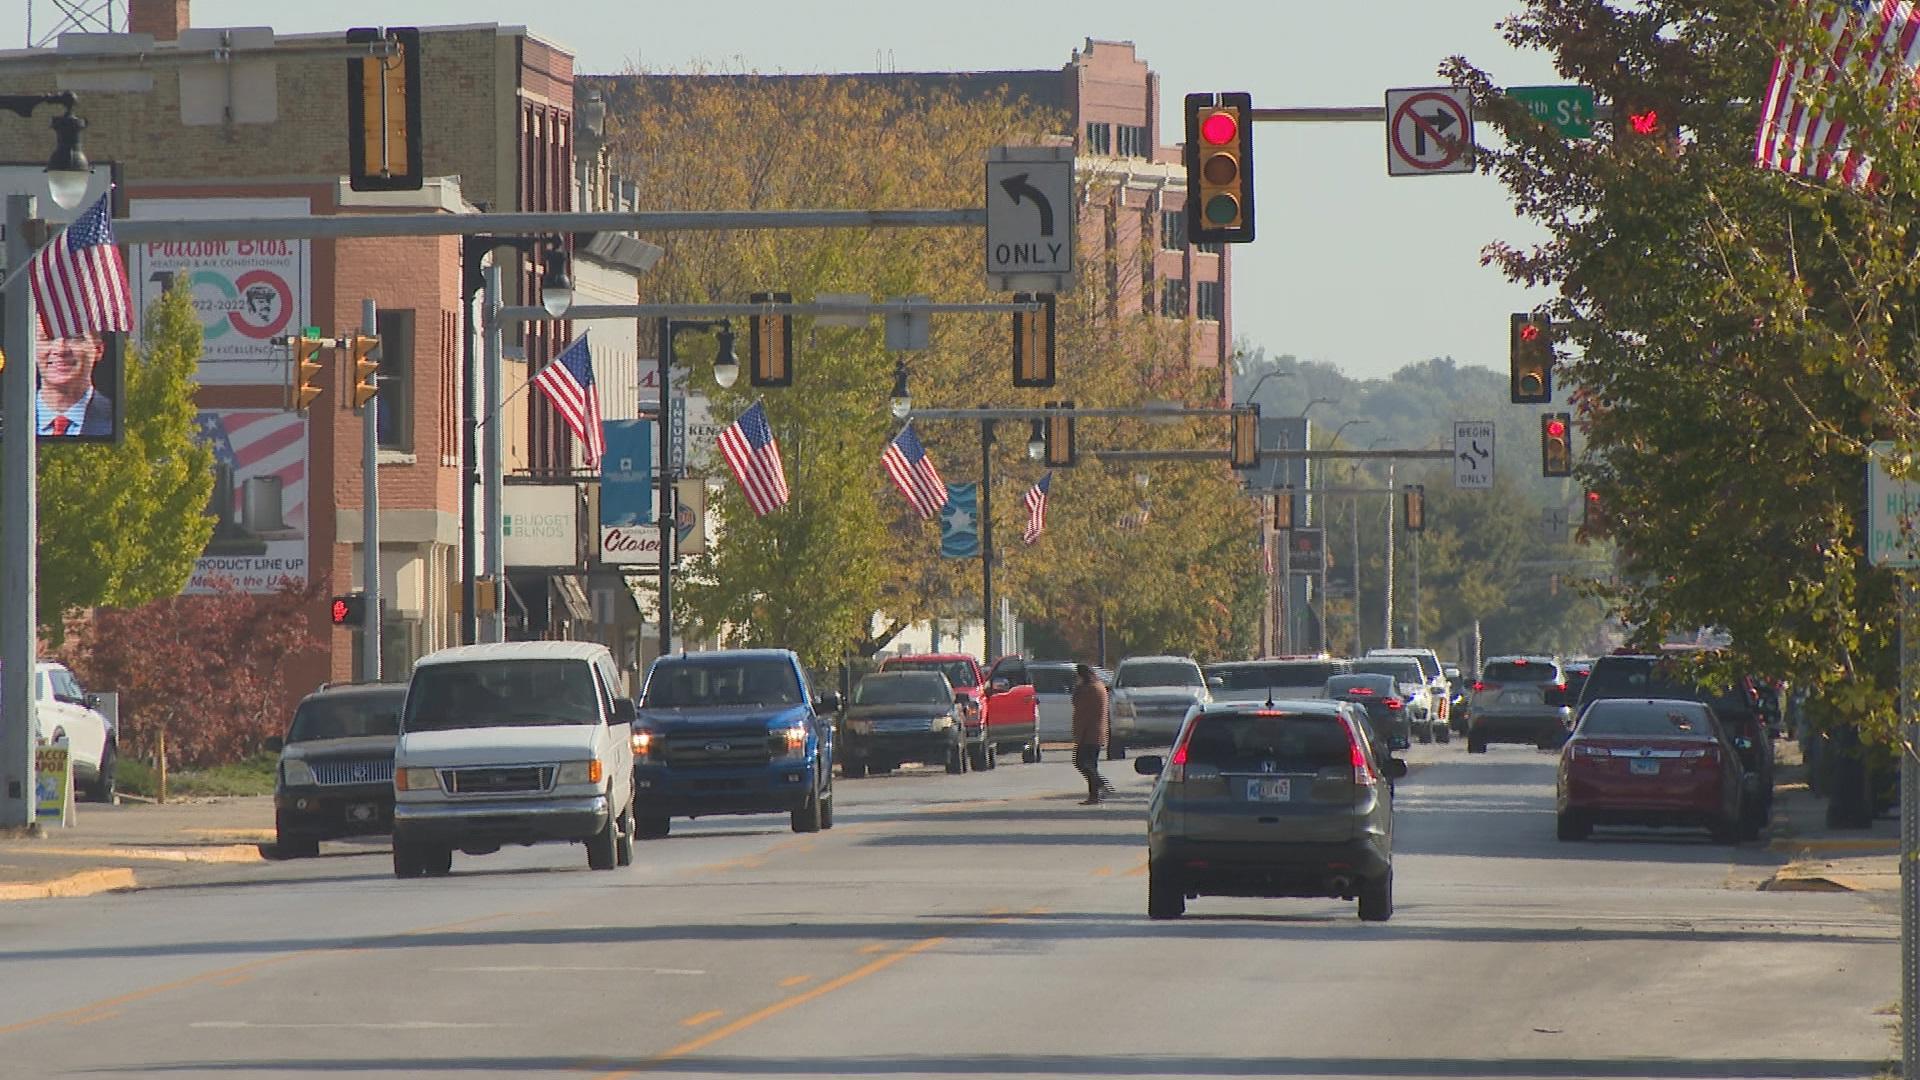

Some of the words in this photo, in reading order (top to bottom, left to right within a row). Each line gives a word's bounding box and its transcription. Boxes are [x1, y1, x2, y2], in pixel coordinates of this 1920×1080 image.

[1557, 100, 1582, 125] St
[238, 239, 293, 257] Bros.
[996, 243, 1062, 265] ONLY
[219, 257, 290, 267] CONDITIONING
[191, 299, 245, 310] 922-2022
[1458, 426, 1490, 438] BEGIN
[1460, 473, 1488, 484] ONLY
[514, 514, 570, 526] BUDGET
[514, 526, 565, 538] BLINDS
[195, 558, 252, 571] RODUCT
[254, 558, 282, 570] LINE
[285, 558, 304, 570] UP
